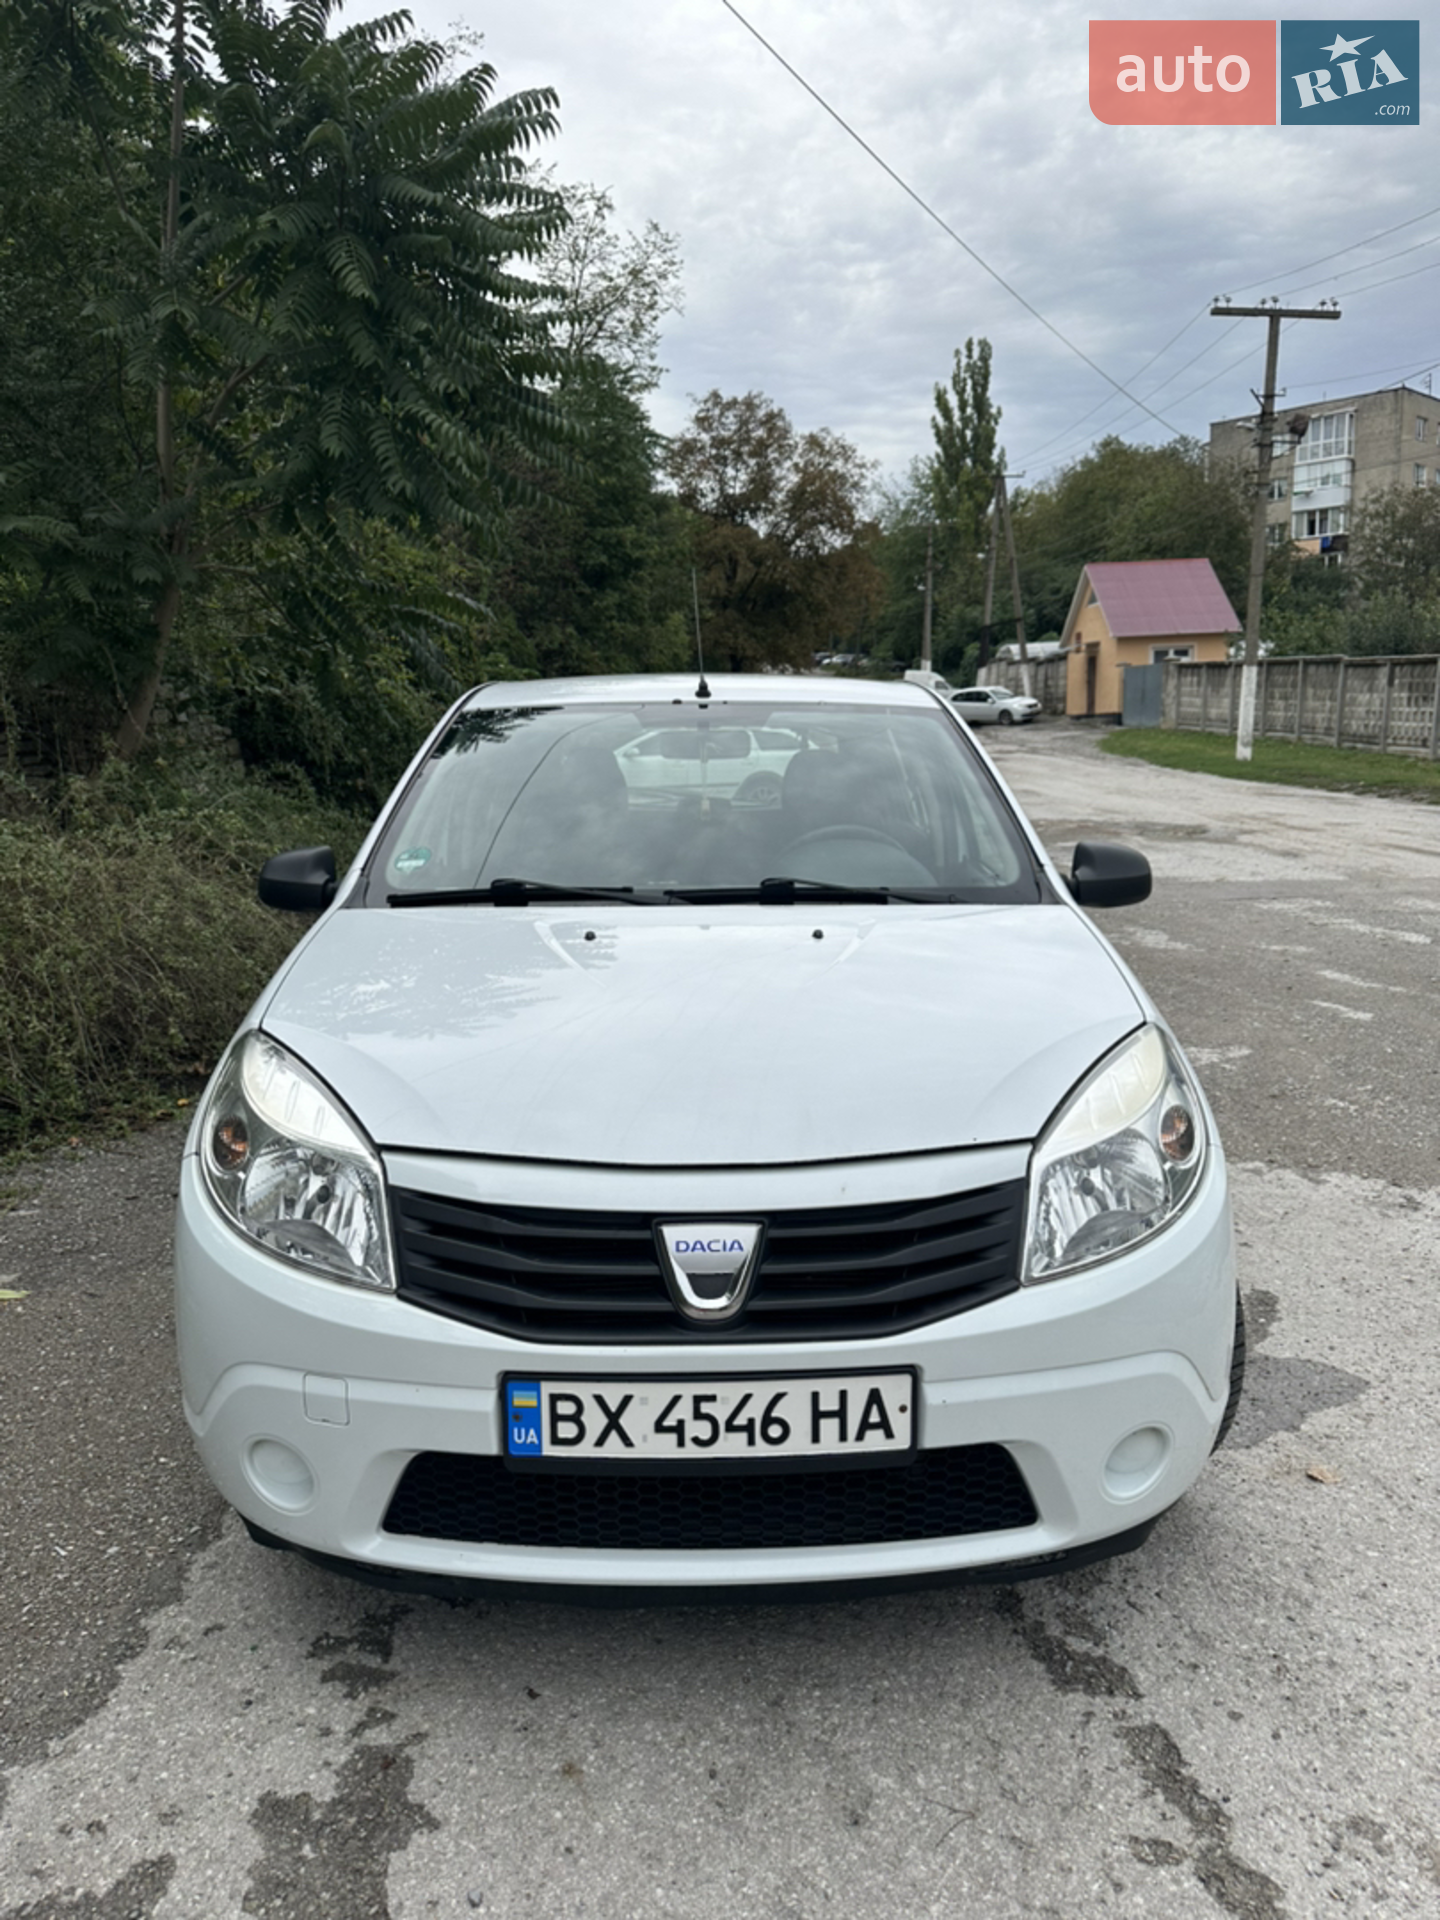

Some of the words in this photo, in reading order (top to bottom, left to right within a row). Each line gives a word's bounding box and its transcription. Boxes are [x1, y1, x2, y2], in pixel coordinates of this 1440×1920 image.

[675, 1239, 744, 1253] DACIA
[549, 1393, 635, 1447] BX
[654, 1392, 791, 1448] 4546
[811, 1387, 895, 1444] HA
[513, 1427, 539, 1444] UA
